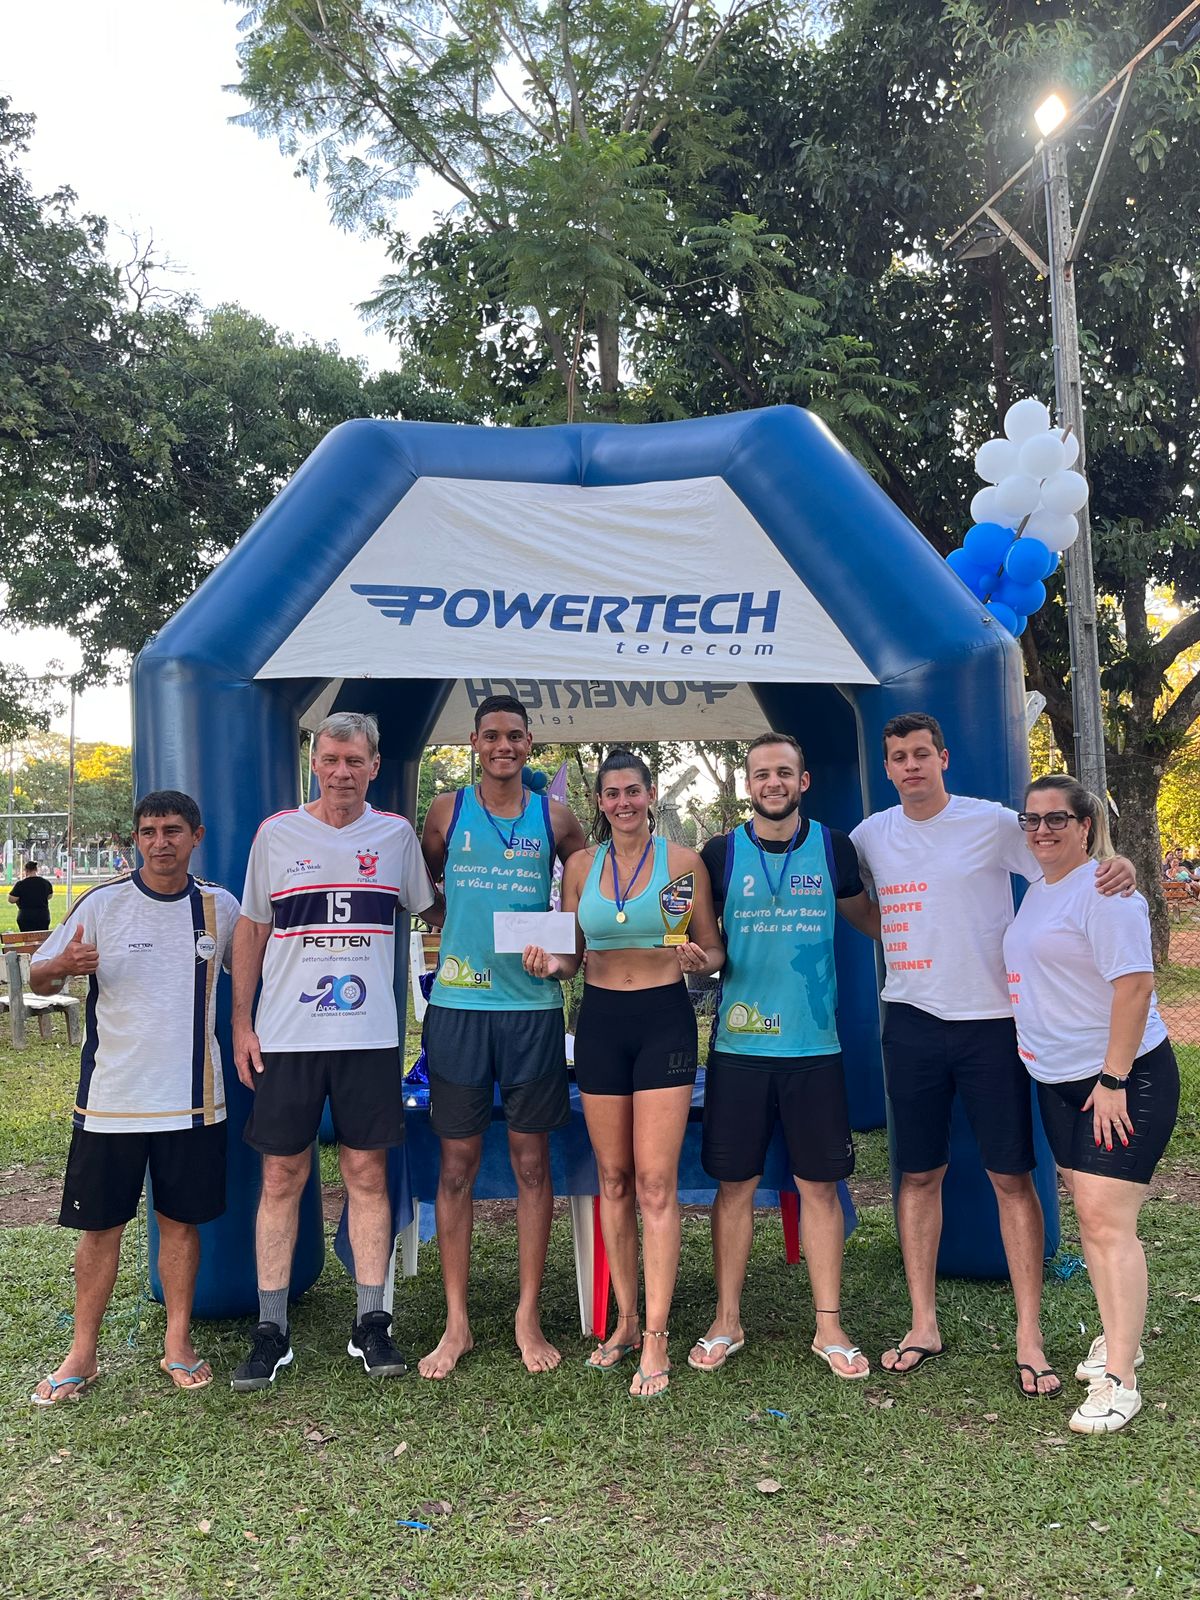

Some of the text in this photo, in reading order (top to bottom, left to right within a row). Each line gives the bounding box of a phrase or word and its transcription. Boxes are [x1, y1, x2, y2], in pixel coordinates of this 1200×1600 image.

[350, 584, 781, 634] POWERTECH
[616, 641, 774, 656] telecom
[462, 831, 471, 851] 1
[452, 864, 488, 873] CIRCUITO
[491, 867, 515, 877] PLAY
[468, 878, 493, 889] VÔLEI
[497, 883, 508, 891] DE
[511, 883, 536, 894] PRAIA
[743, 875, 755, 896] 2
[791, 875, 822, 888] PLAY
[326, 892, 352, 923] 15
[734, 909, 771, 918] CIRCUITO
[775, 907, 798, 917] PLAY
[881, 902, 922, 915] SPORTE
[753, 921, 778, 932] VÔLEI
[782, 924, 793, 932] DE
[796, 923, 821, 933] PRAIA
[882, 920, 909, 934] SAÚDE
[303, 936, 371, 948] PETTEN
[885, 942, 908, 952] LAZER
[302, 955, 370, 963] pettenuniformes.com.br
[889, 959, 932, 971] NTERNET
